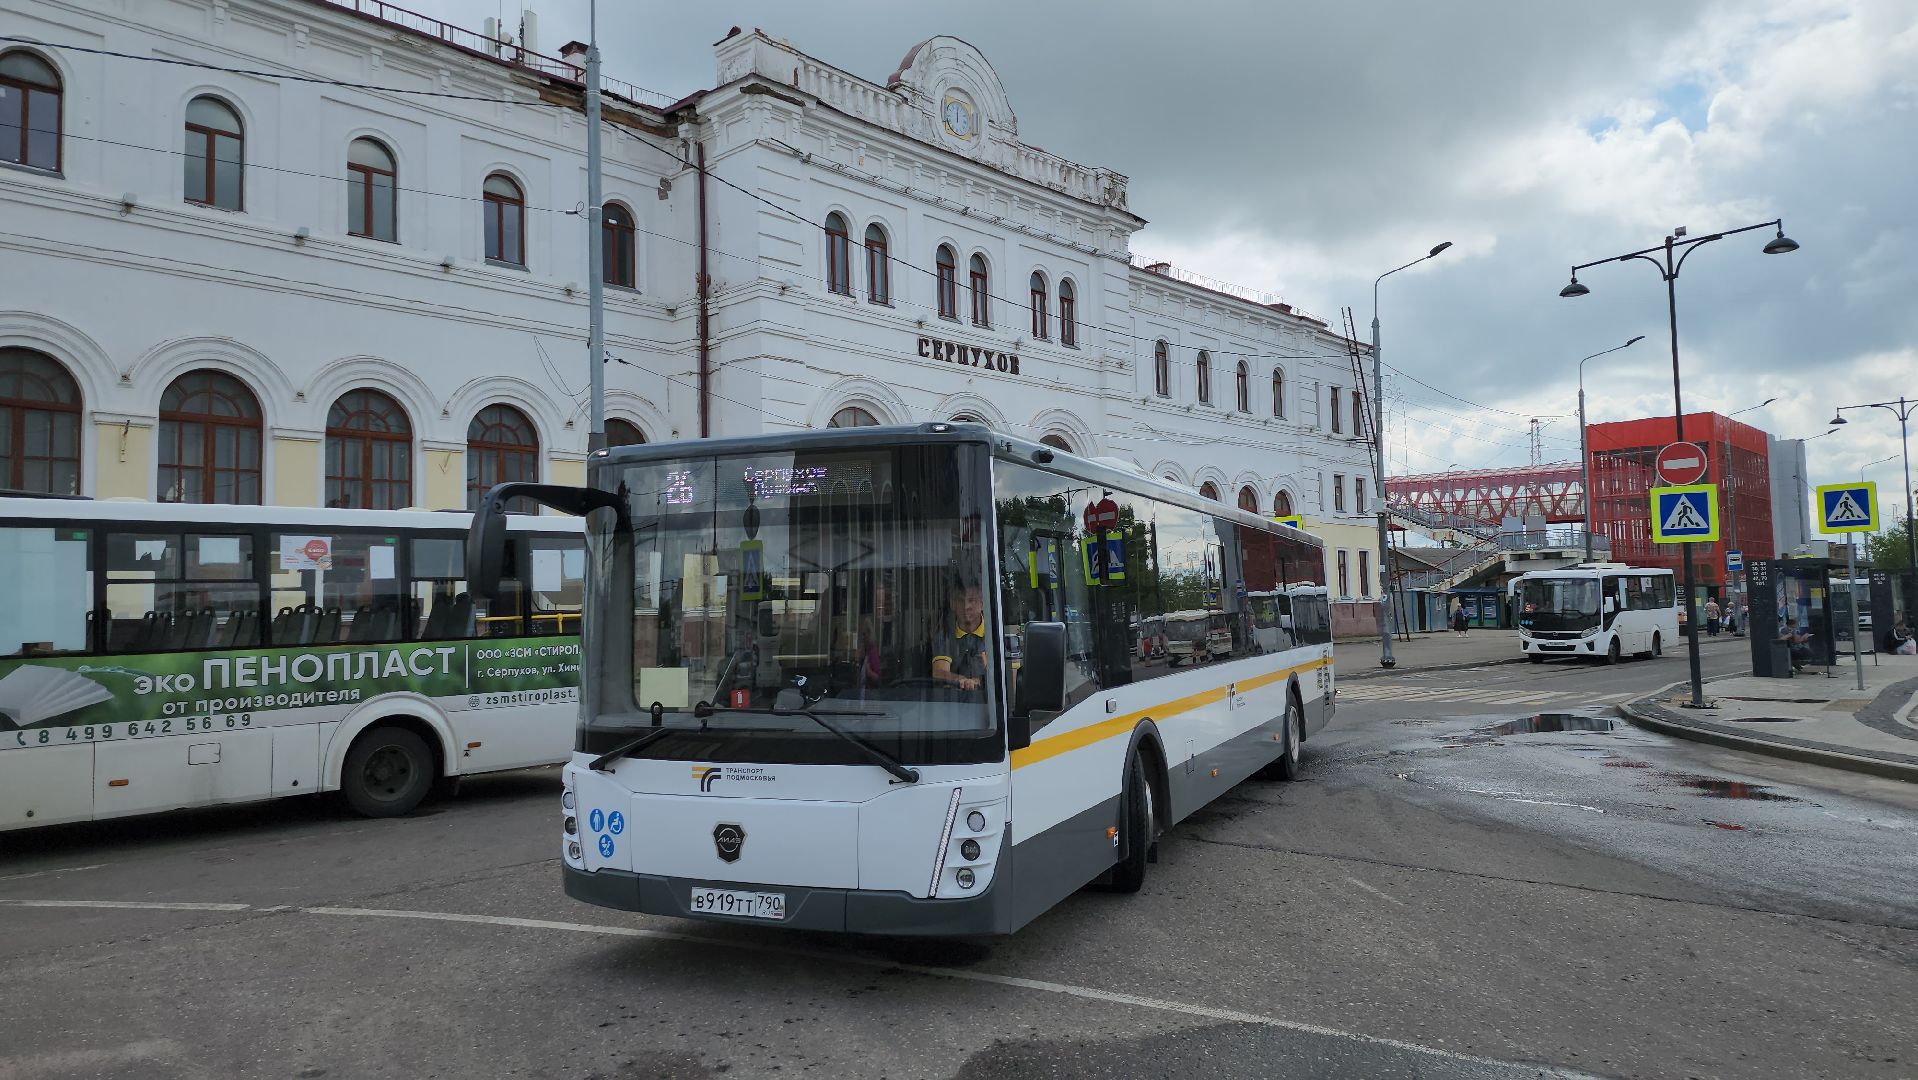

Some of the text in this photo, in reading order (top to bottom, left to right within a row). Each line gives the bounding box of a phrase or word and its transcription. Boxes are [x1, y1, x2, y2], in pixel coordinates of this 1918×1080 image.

[918, 338, 1019, 375] СЕРПУХОВ
[476, 649, 502, 660] ООО
[504, 647, 532, 658] «ЗСМ
[203, 647, 456, 690] ПЕНОПЛАСТ
[477, 669, 484, 678] г.
[486, 667, 539, 679] Серпухов,
[541, 665, 556, 676] ул.
[162, 688, 361, 715] от производителя
[38, 713, 251, 744] 8 499 642 56 69
[726, 774, 776, 782] ПОДМОСКОВЬЯ
[757, 895, 780, 911] 790
